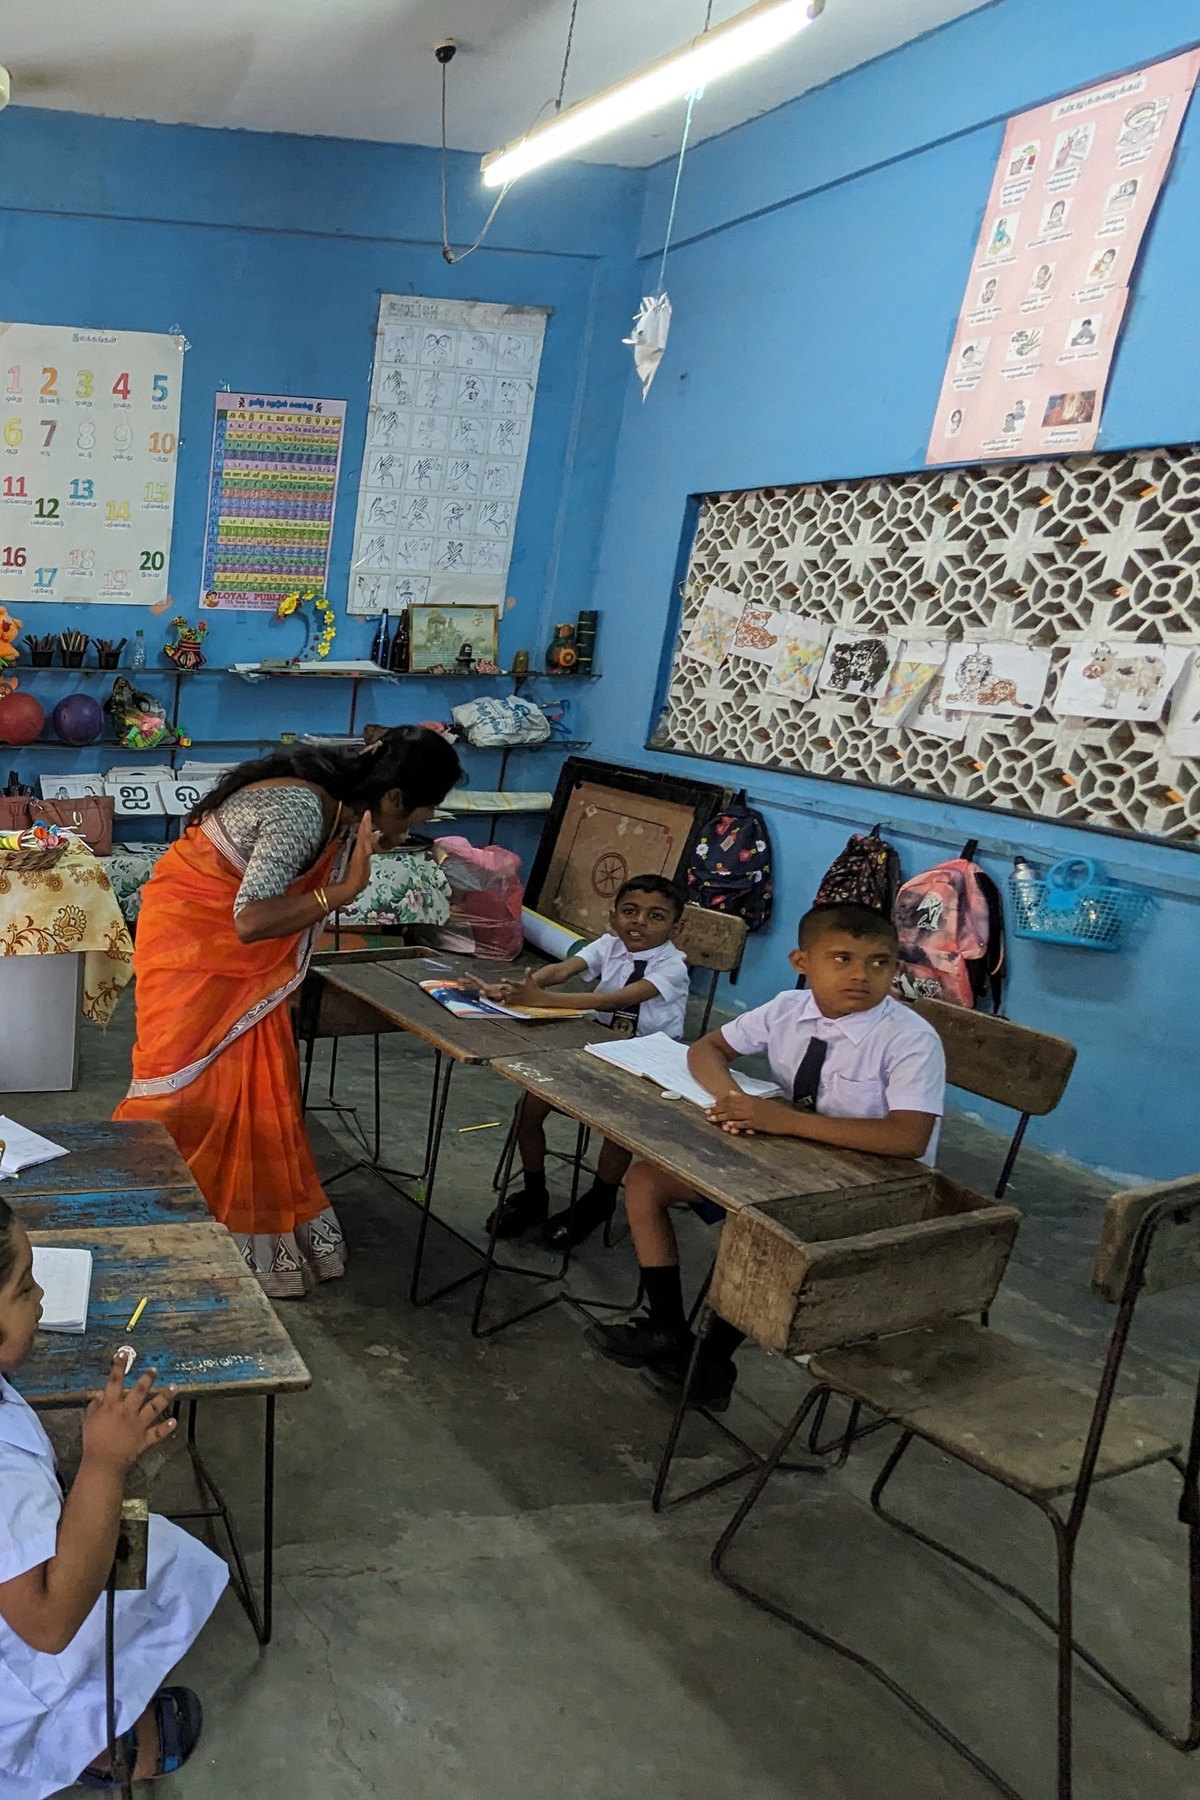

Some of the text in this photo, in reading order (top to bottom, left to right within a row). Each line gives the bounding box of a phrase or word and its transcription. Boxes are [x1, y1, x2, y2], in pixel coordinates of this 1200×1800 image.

[72, 333, 118, 344] இலக்கங்கள்
[6, 365, 23, 394] 1
[40, 367, 58, 395] 2
[76, 369, 94, 398] 3
[112, 373, 131, 400] 4
[152, 374, 168, 402] 5
[4, 418, 23, 446] 6
[40, 420, 58, 447] 7
[77, 421, 96, 450] 8
[114, 424, 133, 451] 9
[148, 432, 175, 454] 10
[3, 476, 28, 498] 11
[69, 478, 94, 500] 13
[143, 482, 168, 503] 15
[34, 497, 60, 518] 12
[105, 501, 131, 521] 14
[2, 546, 27, 568] 16
[69, 549, 95, 570] 18
[139, 550, 165, 571] 20
[34, 567, 58, 588] 17
[103, 569, 129, 590] 19
[217, 592, 288, 601] LOYAL PUBLIC
[120, 785, 150, 810] ஐ
